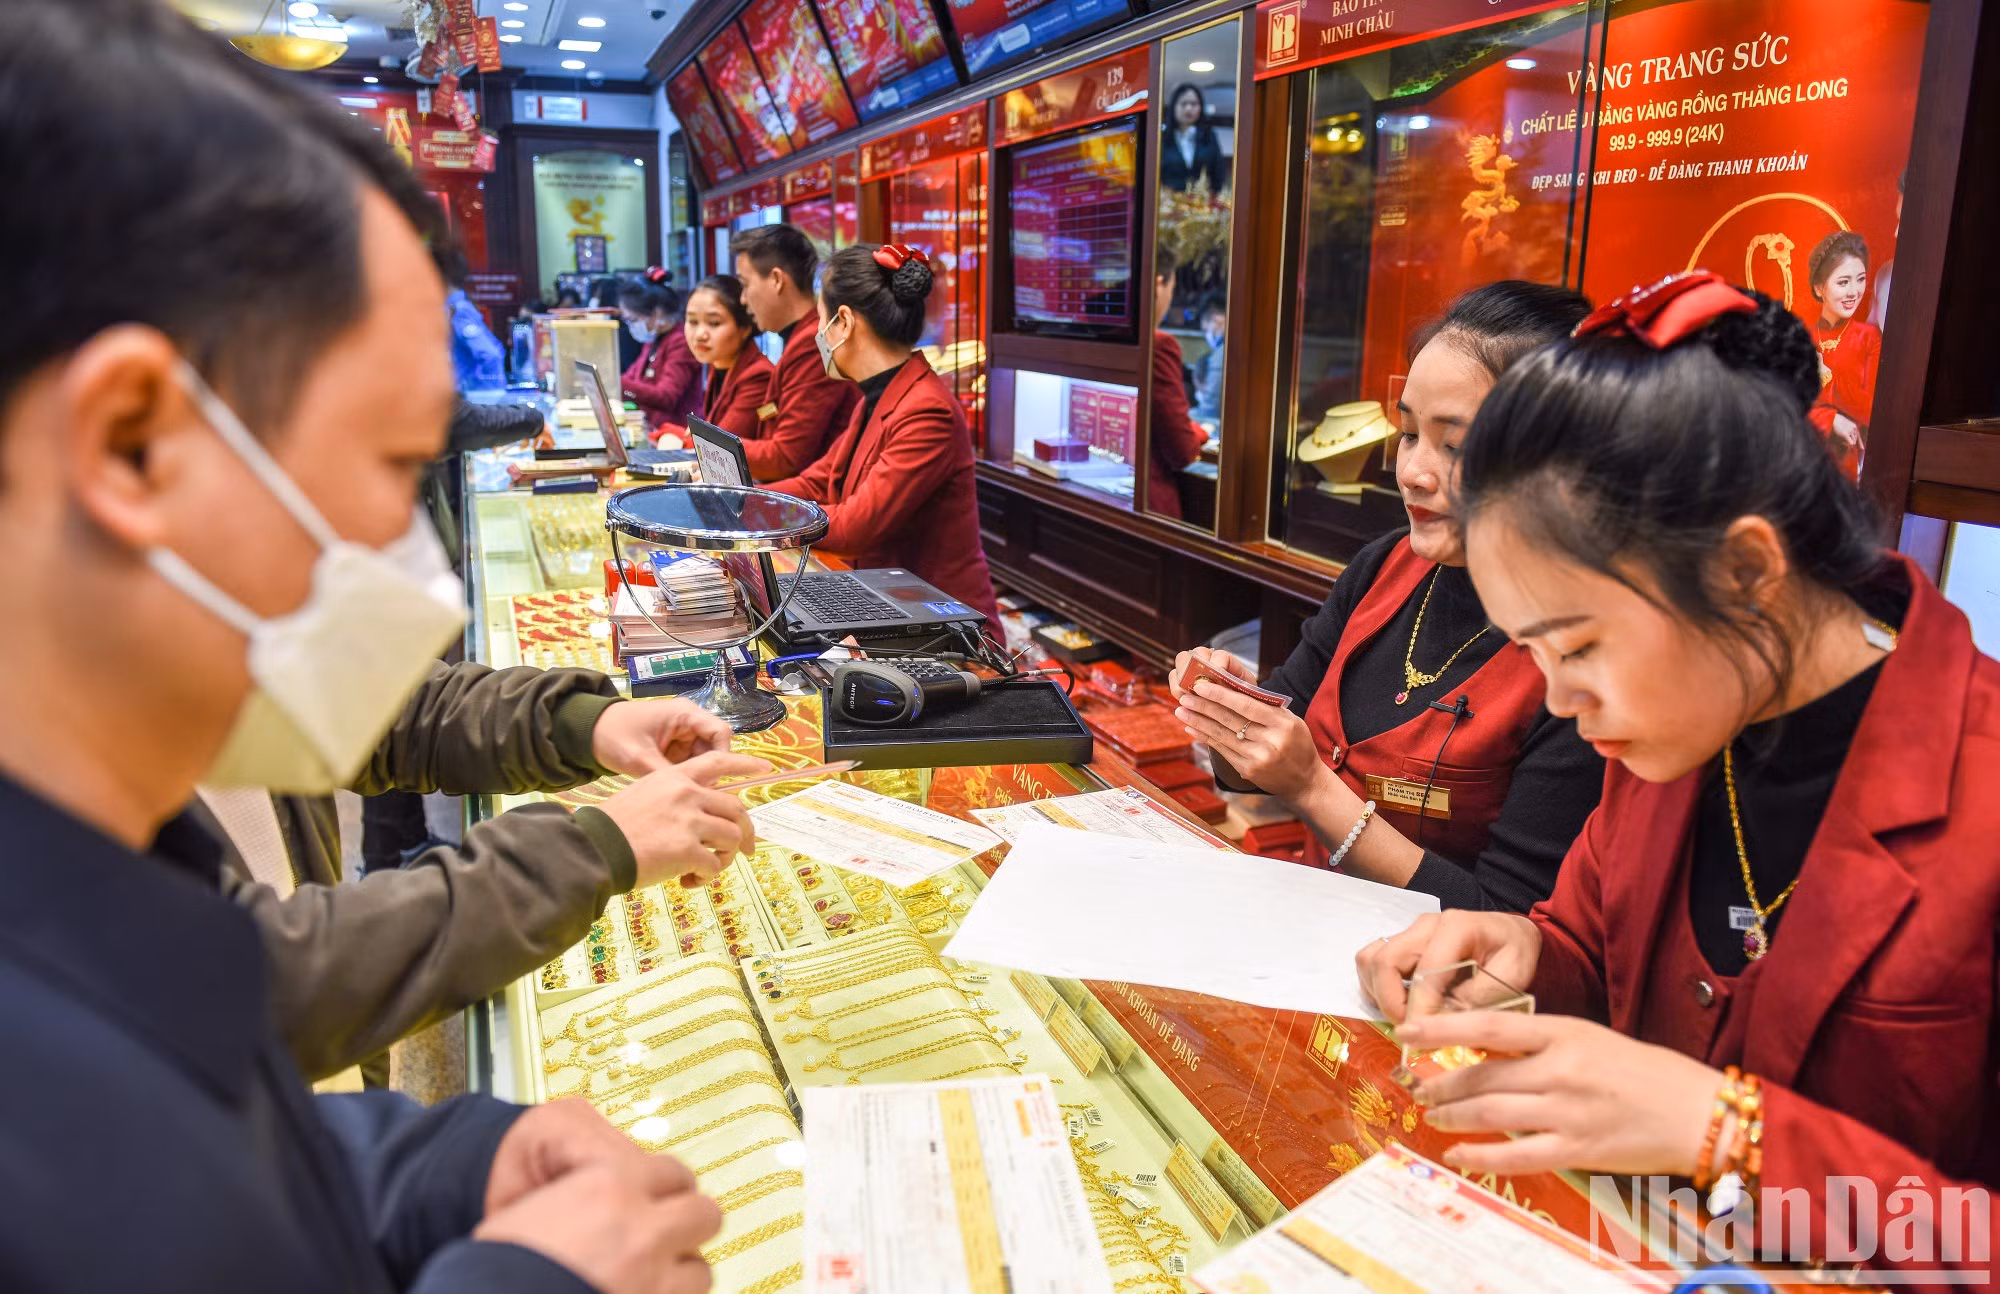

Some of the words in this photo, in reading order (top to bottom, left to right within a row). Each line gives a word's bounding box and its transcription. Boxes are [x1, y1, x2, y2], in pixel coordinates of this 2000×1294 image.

[1320, 22, 1354, 46] MINH
[1357, 9, 1395, 36] CHÂU
[1107, 66, 1124, 87] 139
[1567, 61, 1632, 95] VÀNG
[1639, 47, 1725, 86] TRANG
[1731, 31, 1790, 71] SỨC
[1521, 110, 1555, 136] CHẤT
[1591, 101, 1633, 127] BẰNG
[1636, 98, 1678, 122] VÀNG
[1681, 89, 1728, 116] RỒNG
[1732, 82, 1792, 110] THĂNG
[1796, 77, 1849, 103] LONG
[1609, 133, 1637, 152] 99.9
[1646, 128, 1683, 147] 999.9
[1685, 122, 1725, 147] (24K)
[1531, 171, 1552, 191] ĐẸP
[1592, 170, 1611, 187] KHI
[1613, 168, 1638, 184] ĐEO
[1648, 158, 1666, 182] DỄ
[1668, 161, 1703, 181] DÀNG
[1707, 158, 1753, 178] THANH
[1756, 149, 1809, 174] KHOẢN
[1012, 764, 1043, 800] VÀNG
[1127, 989, 1160, 1029] KHOẢN
[1158, 1022, 1176, 1043] DỄ
